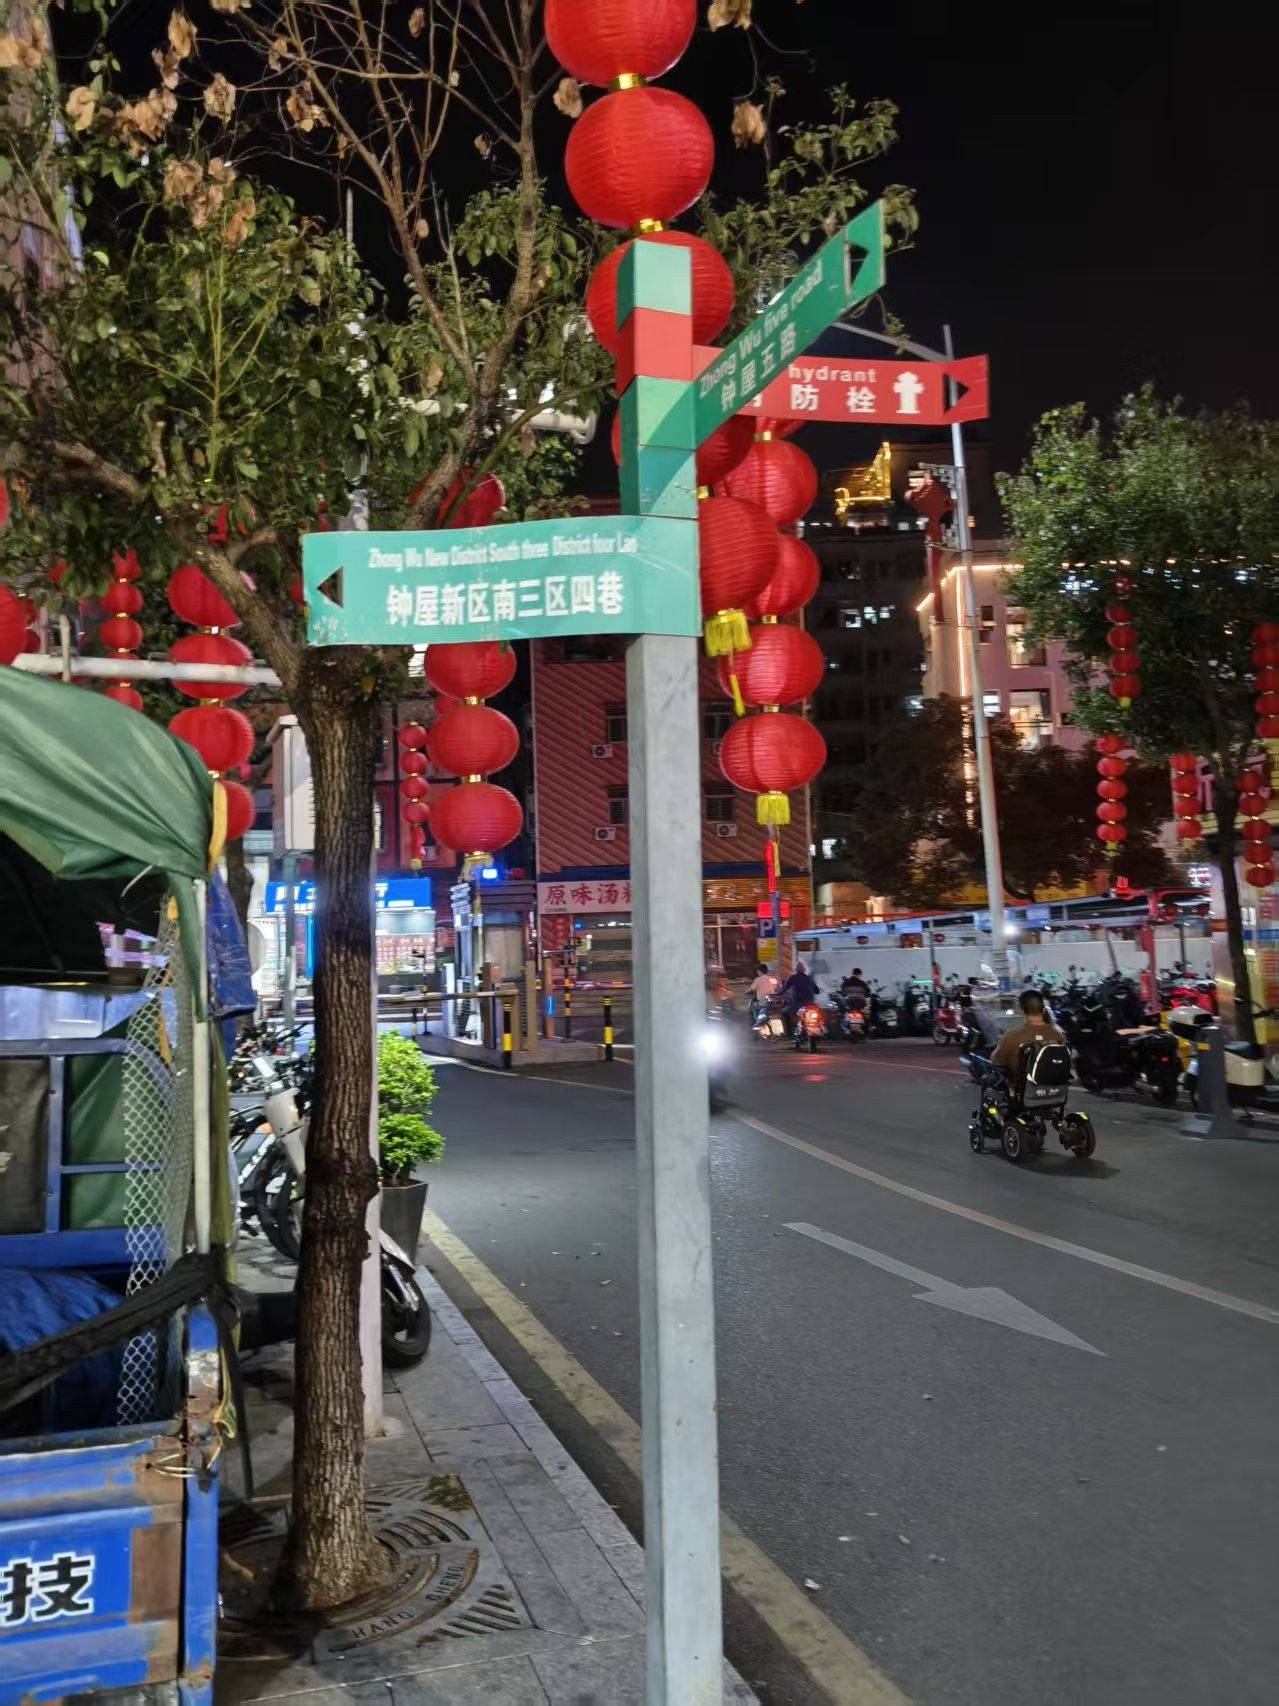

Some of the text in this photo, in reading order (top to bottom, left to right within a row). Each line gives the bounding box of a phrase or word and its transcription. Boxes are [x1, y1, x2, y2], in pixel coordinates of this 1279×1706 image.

[700, 352, 737, 399] Zhong
[764, 303, 789, 339] five
[791, 259, 823, 311] road
[788, 363, 877, 382] hydrant
[368, 547, 403, 572] Zhong
[450, 545, 488, 566] District
[489, 540, 519, 562] South
[521, 538, 549, 560] three
[551, 534, 592, 557] District
[386, 570, 625, 627] 钟屋新区南三区四巷
[0, 1551, 96, 1628] 技
